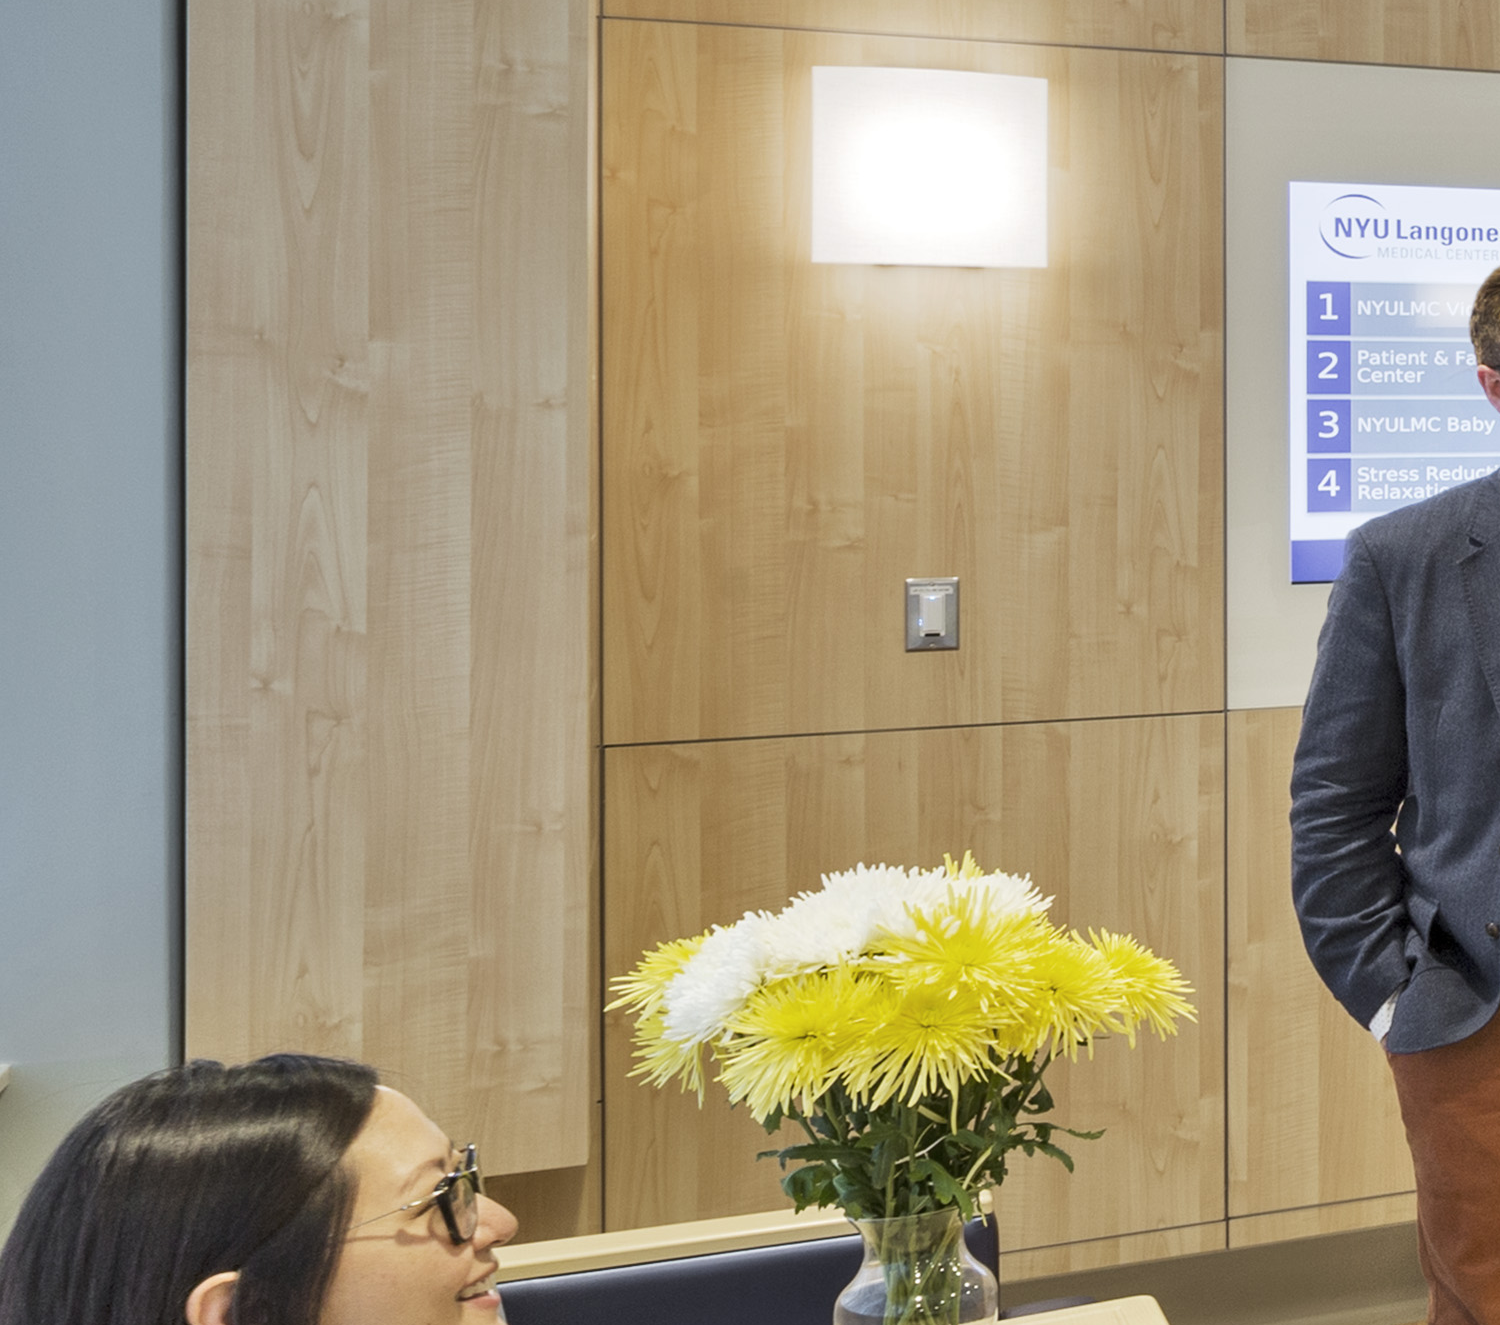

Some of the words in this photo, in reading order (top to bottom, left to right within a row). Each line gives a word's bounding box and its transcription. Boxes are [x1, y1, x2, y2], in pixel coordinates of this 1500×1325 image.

[1334, 217, 1389, 239] NYU
[1396, 219, 1499, 246] Langone
[1377, 246, 1441, 260] MEDICAL
[1445, 248, 1499, 261] CENTER
[1318, 292, 1339, 321] 1
[1356, 300, 1441, 316] NYULMC
[1317, 351, 1339, 379] 2
[1357, 349, 1428, 366] Patient
[1433, 350, 1449, 366] &
[1455, 350, 1477, 366] Fa
[1356, 368, 1425, 383] Center
[1317, 410, 1340, 439] 3
[1357, 417, 1441, 433] NYULMC
[1447, 416, 1496, 436] Baby
[1317, 469, 1340, 497] 4
[1357, 466, 1420, 483] Stress
